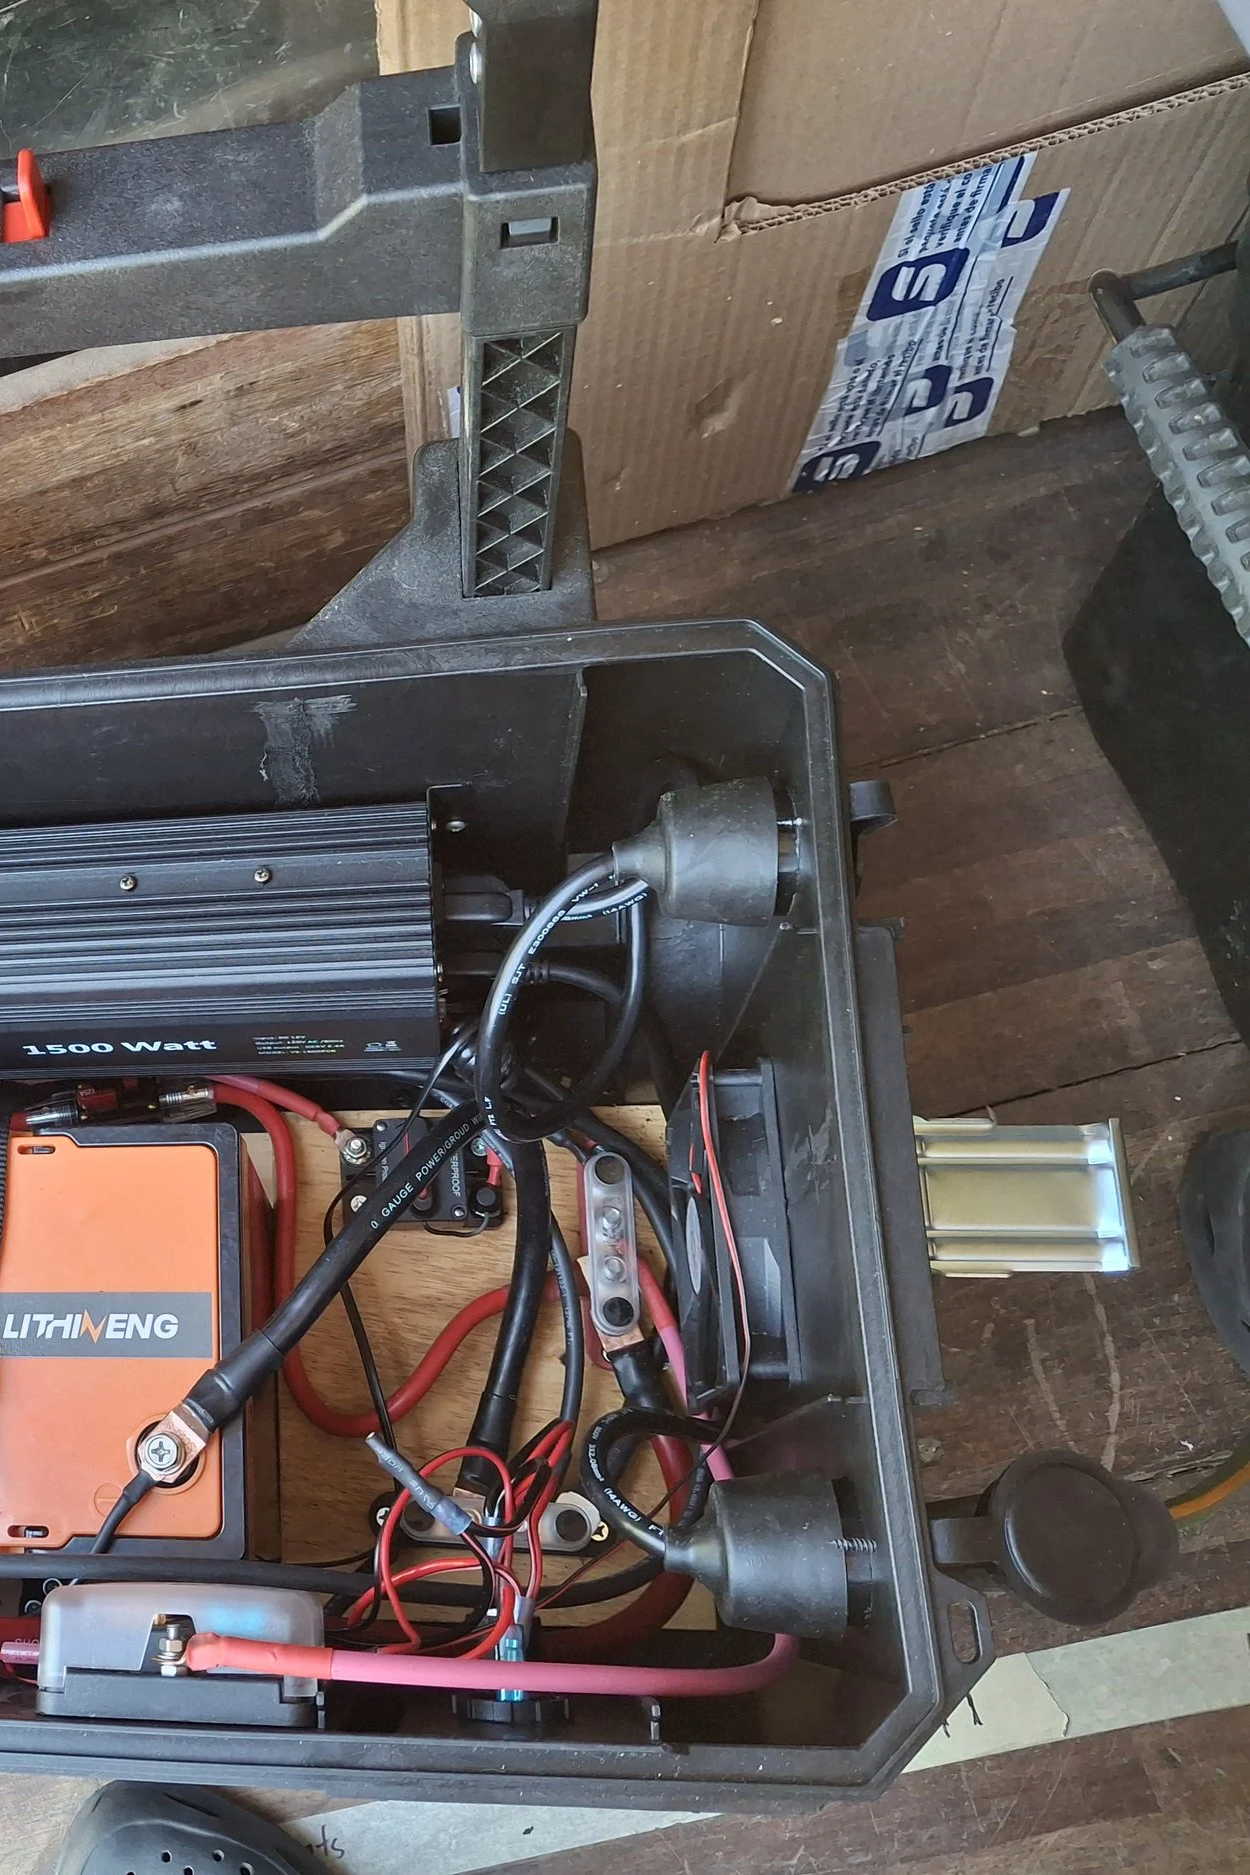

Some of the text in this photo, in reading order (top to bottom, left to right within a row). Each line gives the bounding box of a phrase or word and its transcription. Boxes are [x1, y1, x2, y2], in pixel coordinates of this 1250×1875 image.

[905, 207, 926, 235] sello
[932, 199, 964, 249] verifique
[951, 187, 967, 199] el
[962, 198, 978, 214] de
[602, 892, 648, 916] (14AWG)
[498, 993, 512, 1015] (UL)
[511, 962, 526, 985] SJT
[571, 882, 599, 903] VW-1
[22, 1040, 217, 1055] 1500 Watt
[370, 1220, 379, 1230] 0
[381, 1182, 415, 1217] GAUGE
[415, 1123, 470, 1182] POWER/GROUD
[603, 1487, 642, 1522] (14AWG)
